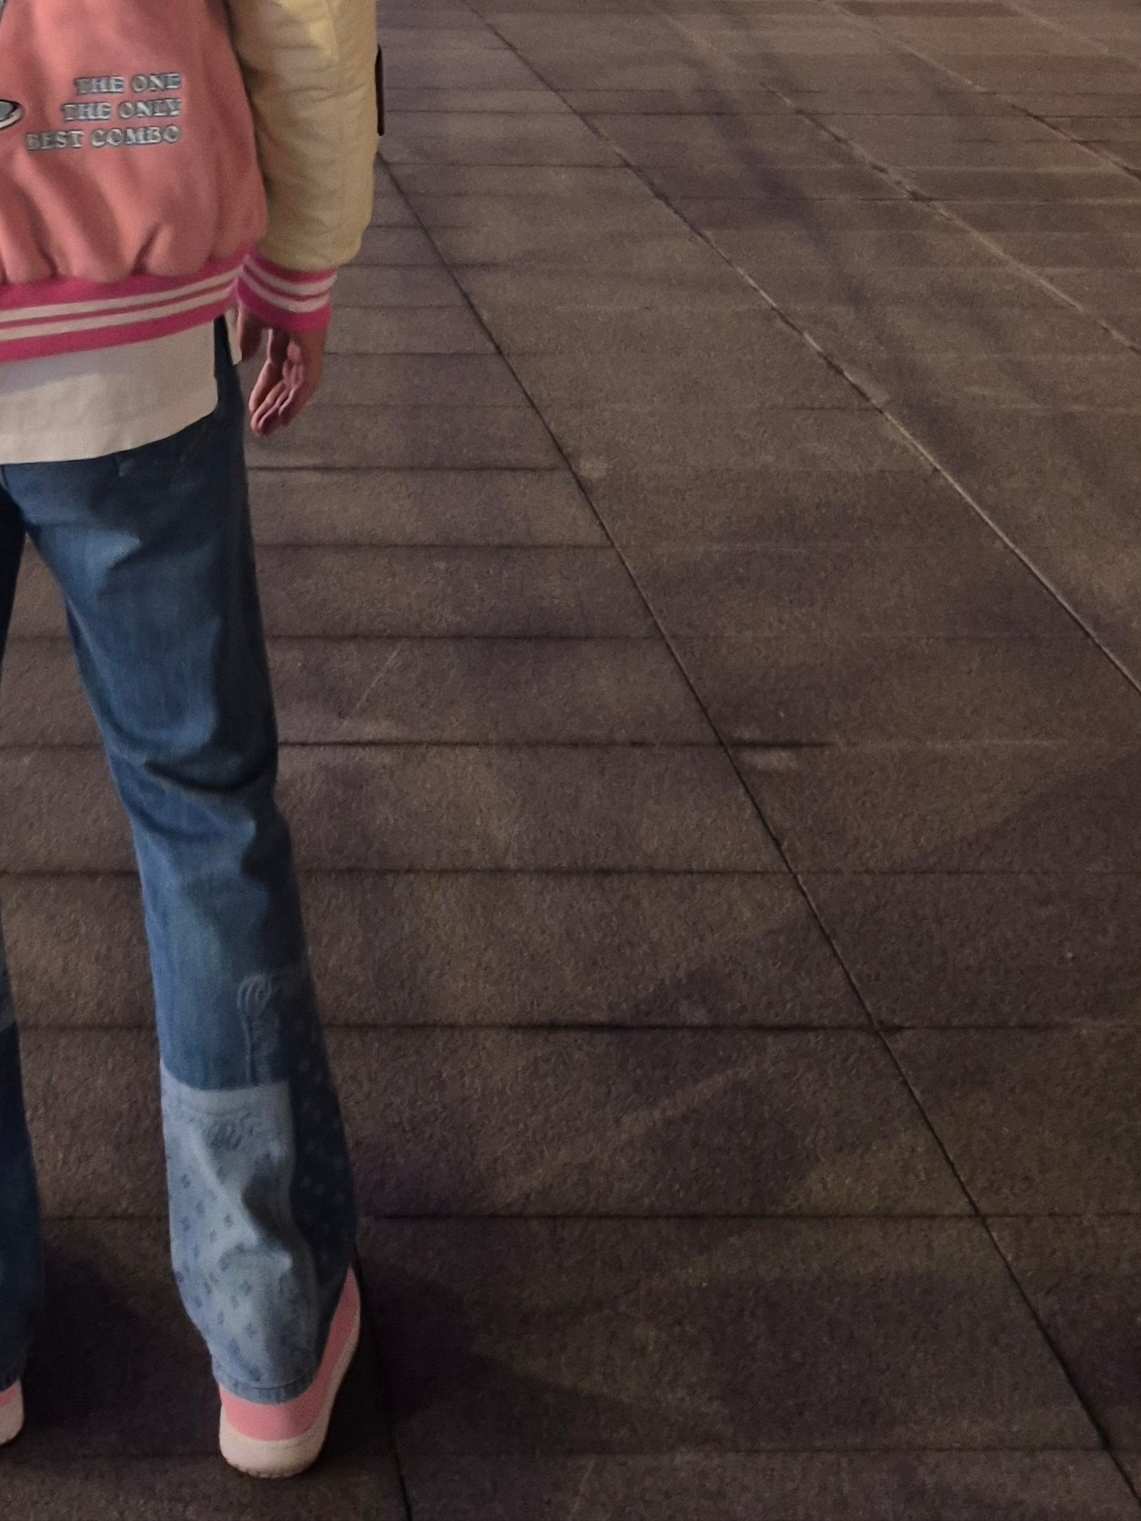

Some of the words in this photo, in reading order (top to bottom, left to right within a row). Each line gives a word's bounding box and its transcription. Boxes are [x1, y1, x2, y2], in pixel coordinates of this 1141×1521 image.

[74, 76, 125, 95] THE
[131, 73, 182, 93] ONE
[62, 102, 112, 121] THE
[118, 98, 182, 120] ONLY
[26, 130, 84, 151] BEST
[90, 124, 182, 148] COMBO
